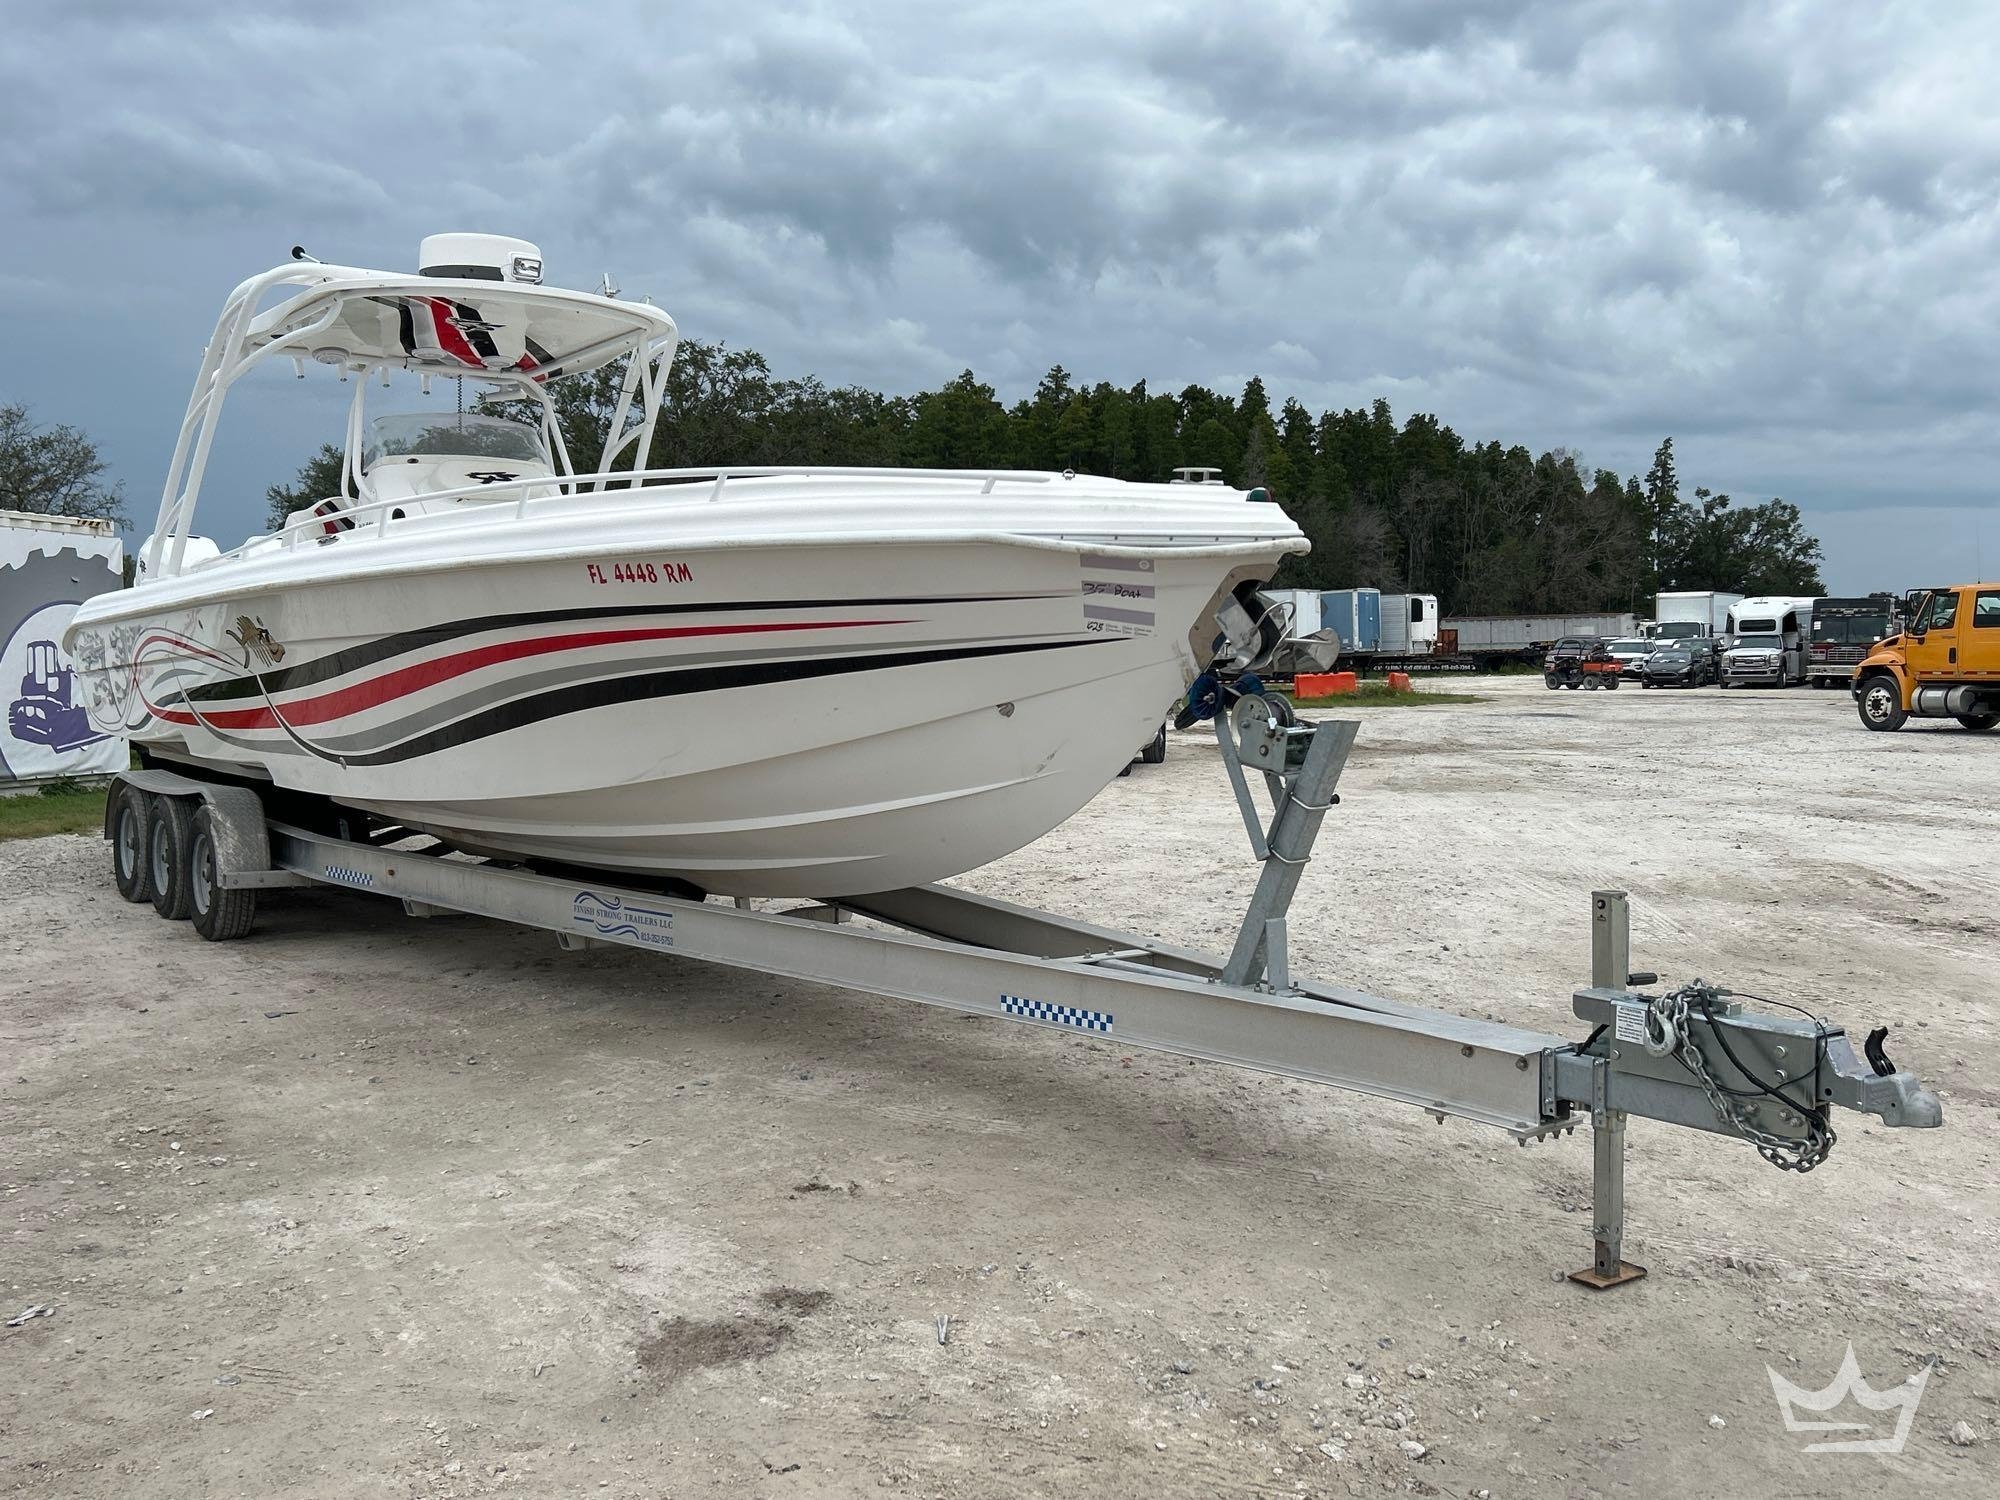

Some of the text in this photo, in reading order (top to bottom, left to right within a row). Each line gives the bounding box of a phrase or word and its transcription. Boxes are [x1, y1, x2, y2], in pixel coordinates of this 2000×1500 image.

[587, 563, 693, 584] FL 4448 RM
[574, 904, 673, 929] FINISH STRONG TRAILERS LLC
